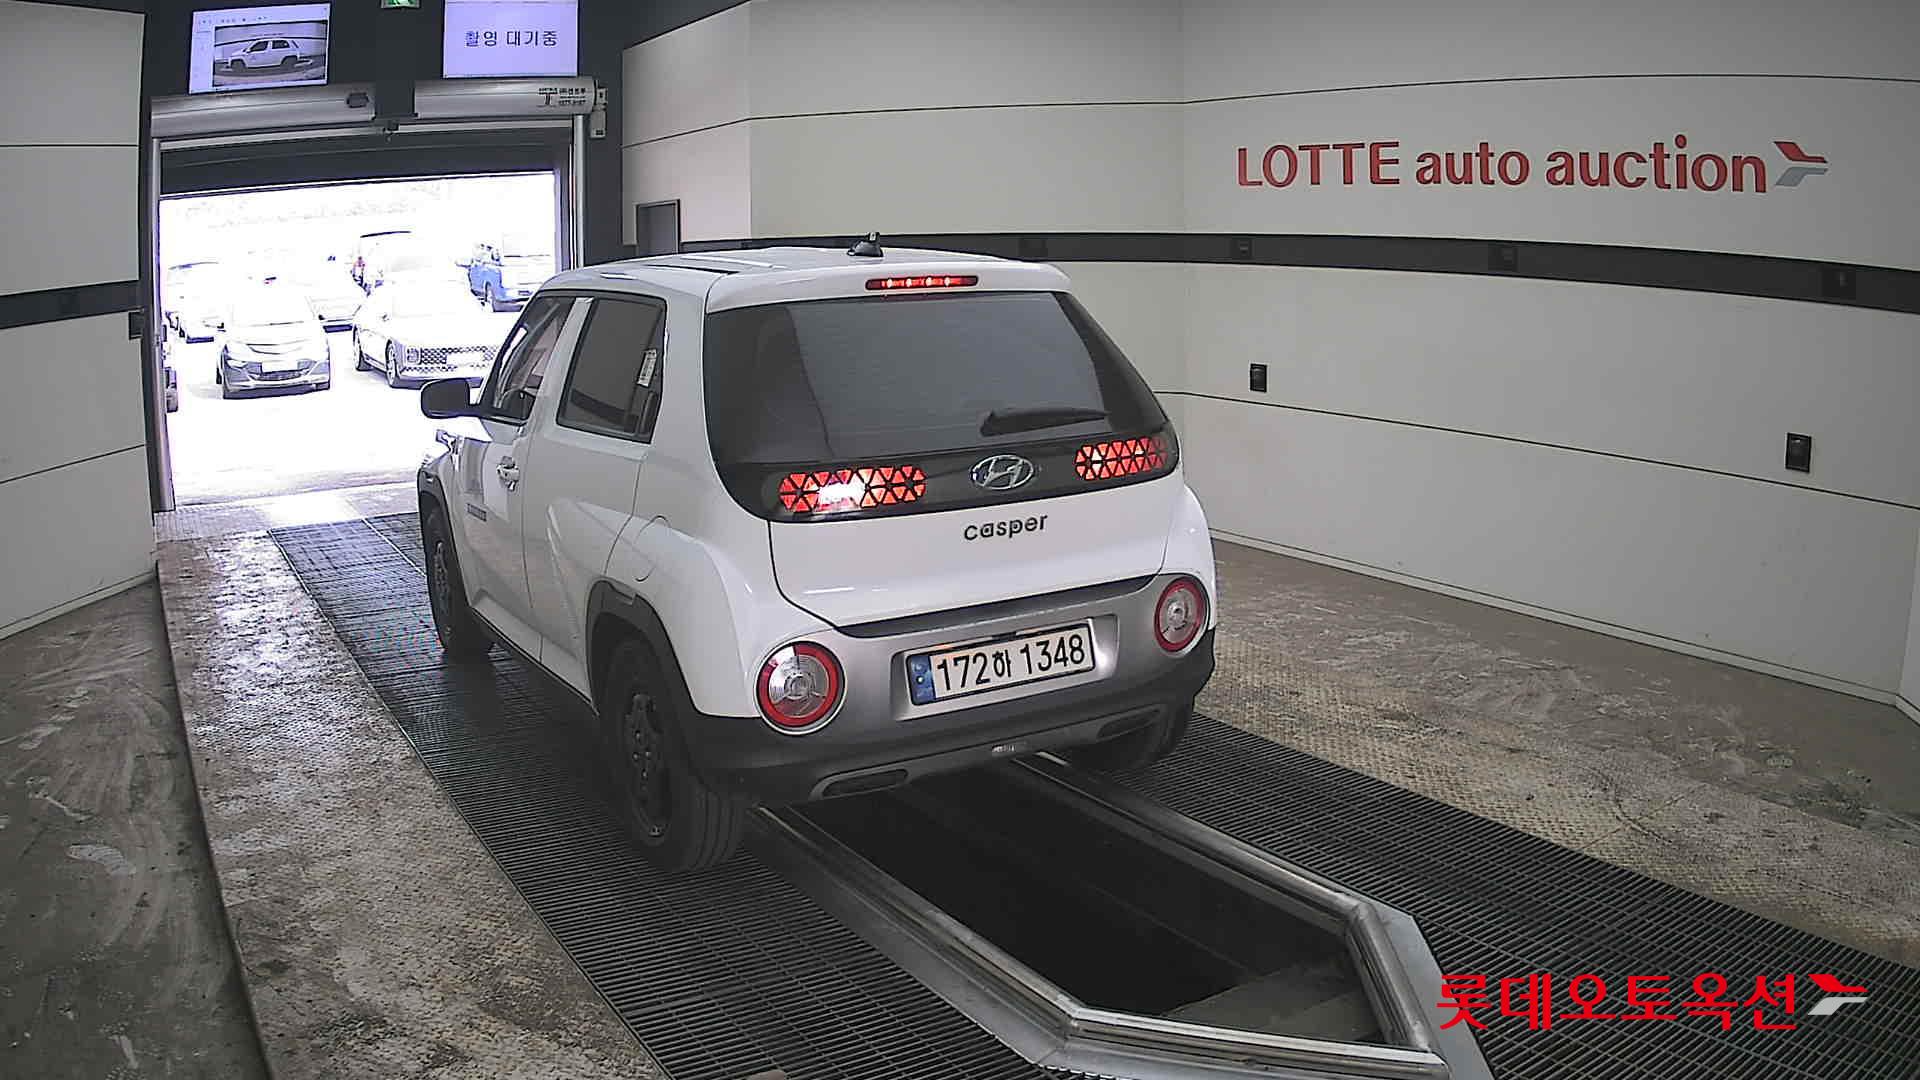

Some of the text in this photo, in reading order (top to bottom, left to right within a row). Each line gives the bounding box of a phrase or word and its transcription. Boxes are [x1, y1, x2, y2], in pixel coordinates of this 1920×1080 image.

[506, 30, 558, 47] 대기중
[1236, 134, 1767, 193] LOTTE auto auction
[963, 514, 1048, 541] casper
[937, 633, 1085, 691] 172하 1348
